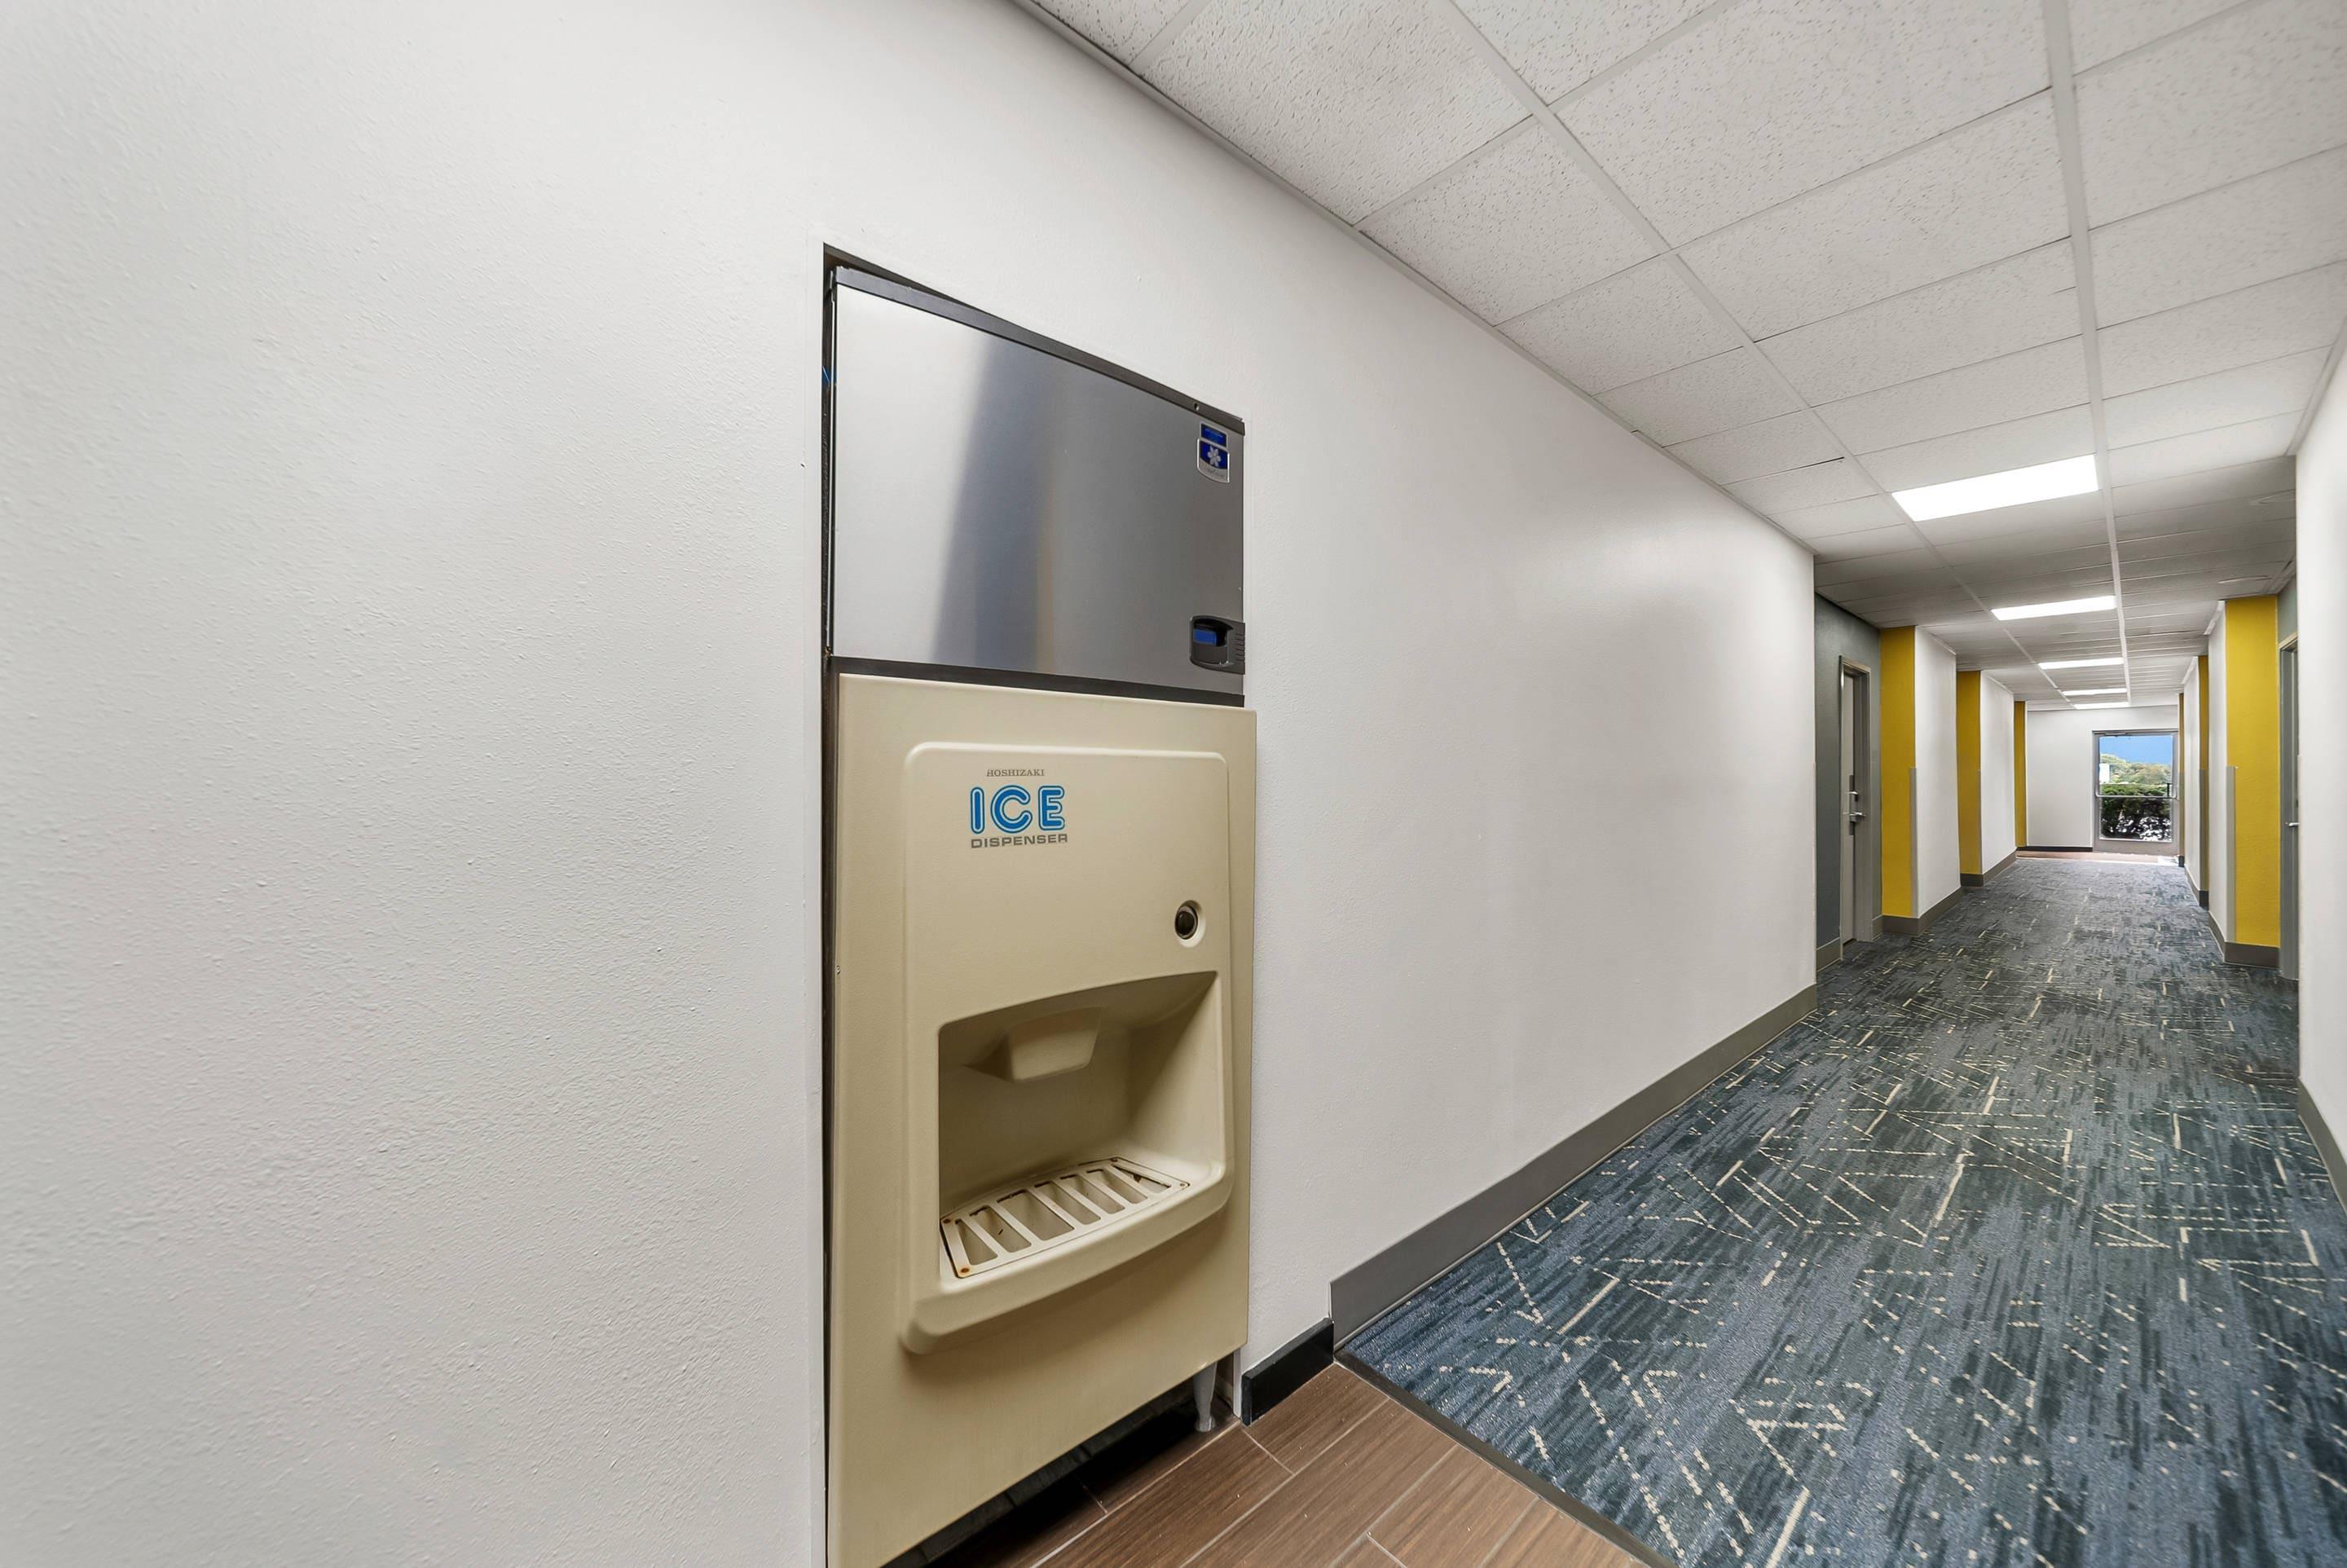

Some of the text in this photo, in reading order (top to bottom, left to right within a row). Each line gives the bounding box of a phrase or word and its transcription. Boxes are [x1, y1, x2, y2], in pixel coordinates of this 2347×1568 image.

[986, 769, 1046, 777] HOSHIZAKI
[971, 785, 1065, 834] ICE
[971, 834, 1068, 848] DISPENSER
